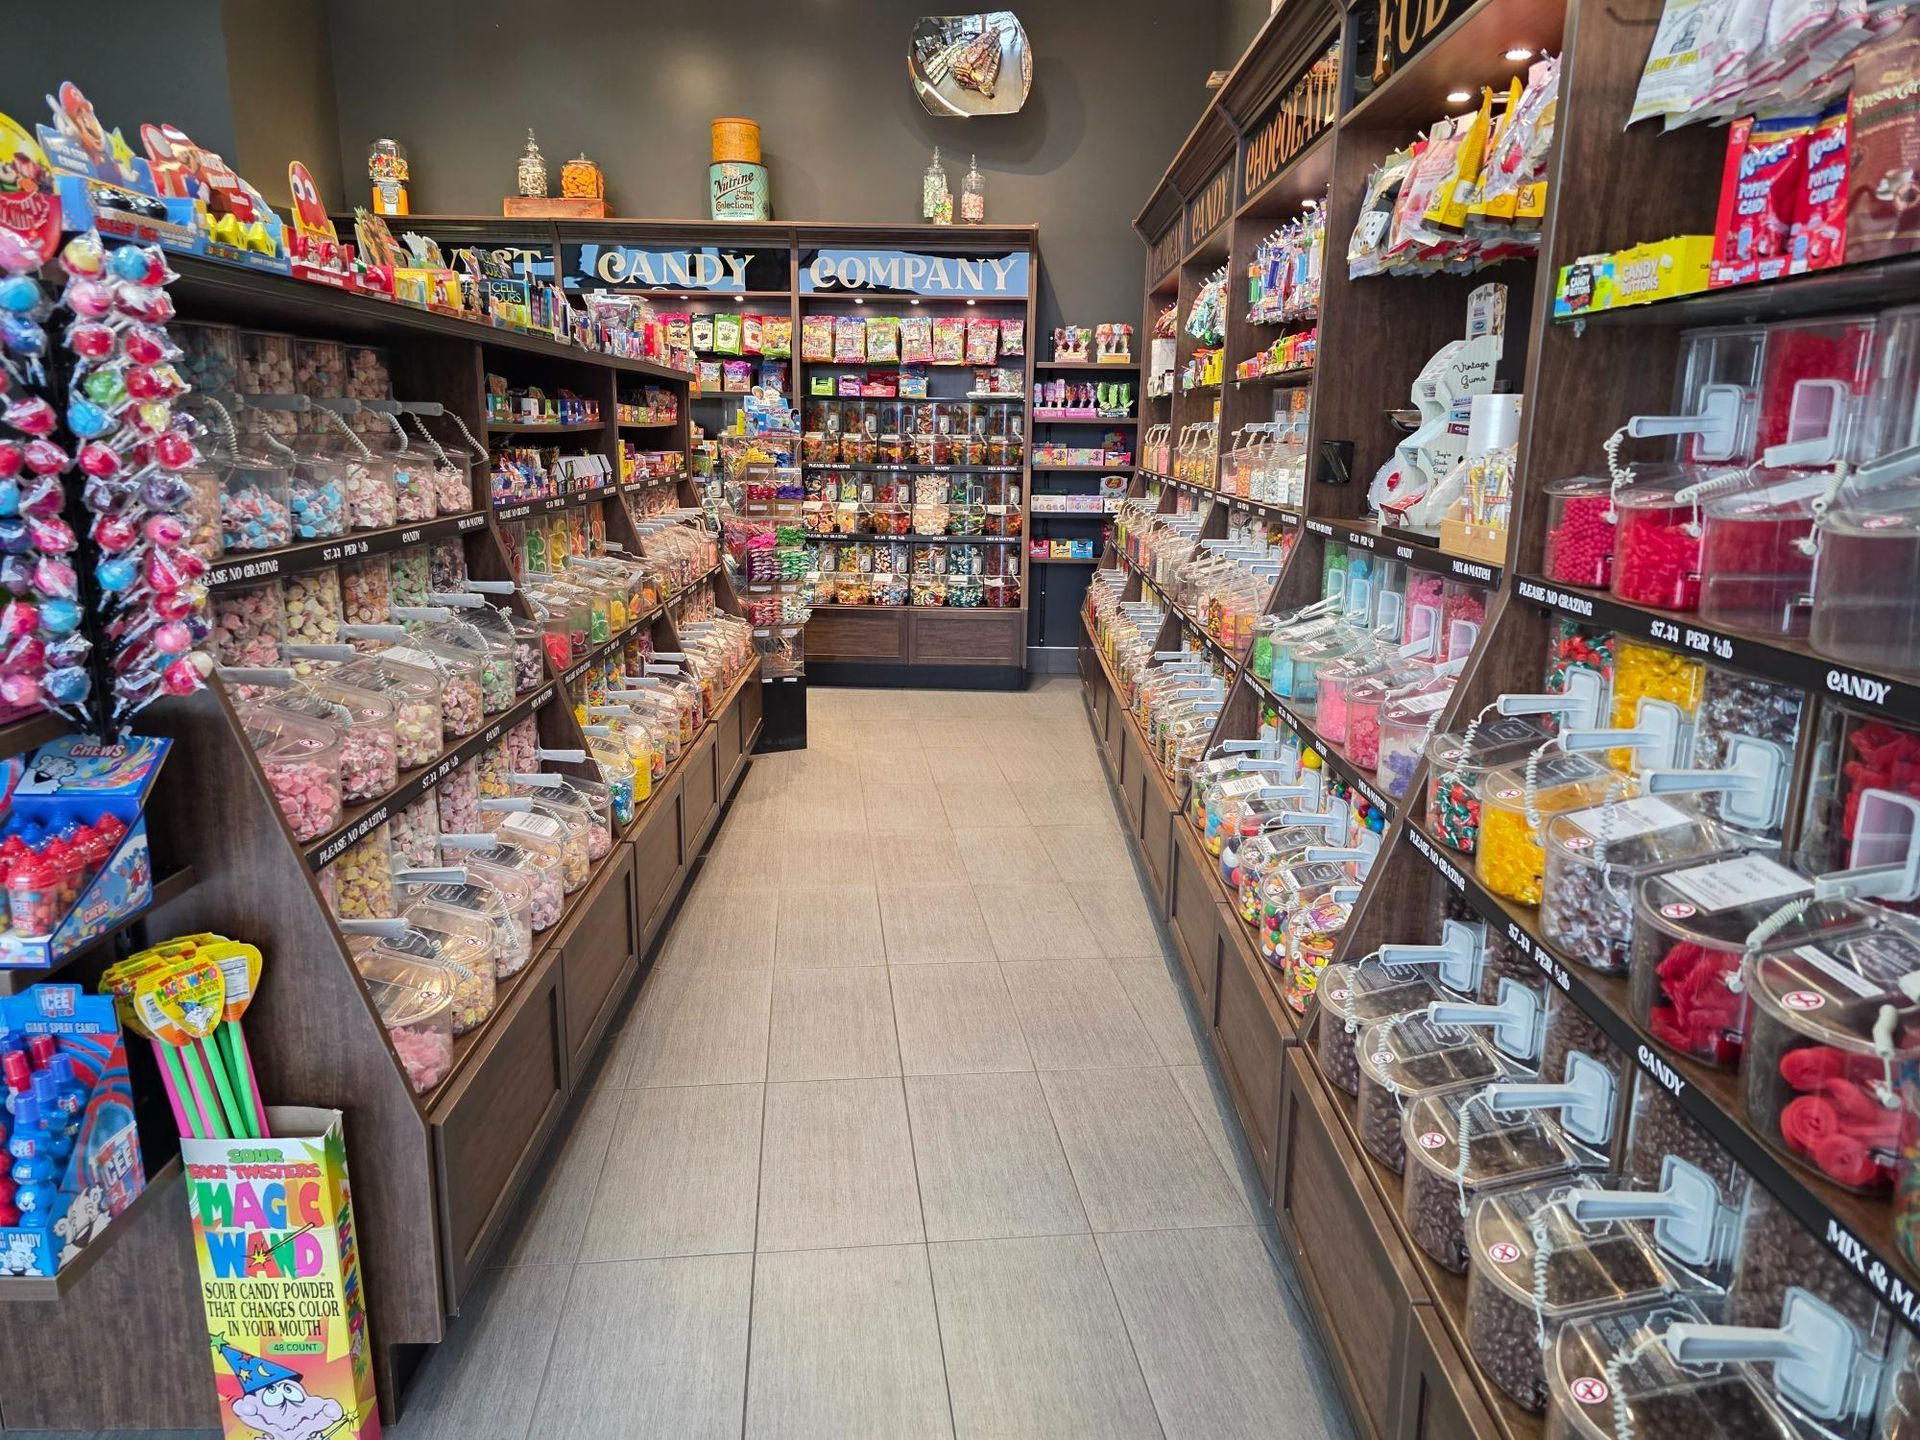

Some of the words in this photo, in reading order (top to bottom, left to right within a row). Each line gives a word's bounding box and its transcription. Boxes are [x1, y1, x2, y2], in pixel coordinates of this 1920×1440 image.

[713, 172, 755, 199] Nutrine
[1191, 167, 1230, 245] CANDY
[598, 251, 755, 286] CANDY
[809, 256, 1018, 290] COMPANY
[1623, 257, 1661, 283] CANDY
[491, 282, 517, 294] CELL
[1621, 276, 1660, 297] BUTTONS
[1453, 361, 1490, 373] Vintage
[1461, 375, 1487, 389] Gums
[402, 530, 420, 543] CANDY
[343, 544, 357, 556] PER
[203, 569, 228, 587] EASE
[229, 566, 242, 581] NO
[244, 560, 279, 578] GRAZING
[1518, 582, 1546, 602] PLEASE
[1545, 590, 1558, 605] NO
[1557, 594, 1593, 617] GRAZING
[1685, 629, 1710, 652] PER
[1826, 669, 1892, 705] CANDY
[485, 725, 500, 743] CANDY
[69, 743, 125, 758] CHEWS
[319, 836, 347, 865] PLEASE
[348, 828, 358, 844] NO
[359, 807, 388, 835] GRAZING
[1409, 829, 1430, 857] PLEASE
[1429, 847, 1439, 865] NO
[1438, 857, 1466, 891] GRAZING
[84, 901, 109, 922] CHEWS
[1534, 946, 1553, 975] PER
[155, 977, 188, 1003] MAGIC
[186, 966, 218, 988] WAND
[40, 993, 71, 1011] ICEE
[25, 1022, 48, 1034] GIANT
[50, 1022, 73, 1034] SPRAY
[75, 1022, 100, 1034] CANDY
[1637, 1045, 1686, 1098] CANDY
[227, 1148, 284, 1163] SOUR
[189, 1164, 229, 1179] FACE
[231, 1163, 322, 1179] TWISTERS
[199, 1181, 325, 1229] MAGIC
[8, 1232, 41, 1248] CANDY
[204, 1230, 324, 1279] WAND
[1826, 1220, 1868, 1273] MIX
[1868, 1261, 1889, 1293] &
[205, 1282, 237, 1300] SOUR
[239, 1282, 281, 1300] CANDY
[284, 1282, 335, 1299] POWDER
[207, 1301, 236, 1318] THAT
[241, 1301, 297, 1319] CHANGES
[299, 1300, 341, 1317] COLOR
[228, 1320, 240, 1337] IN
[243, 1320, 277, 1337] YOUR
[279, 1320, 322, 1337] MOUTH
[274, 1344, 284, 1352] 48
[286, 1343, 319, 1352] COUNT
